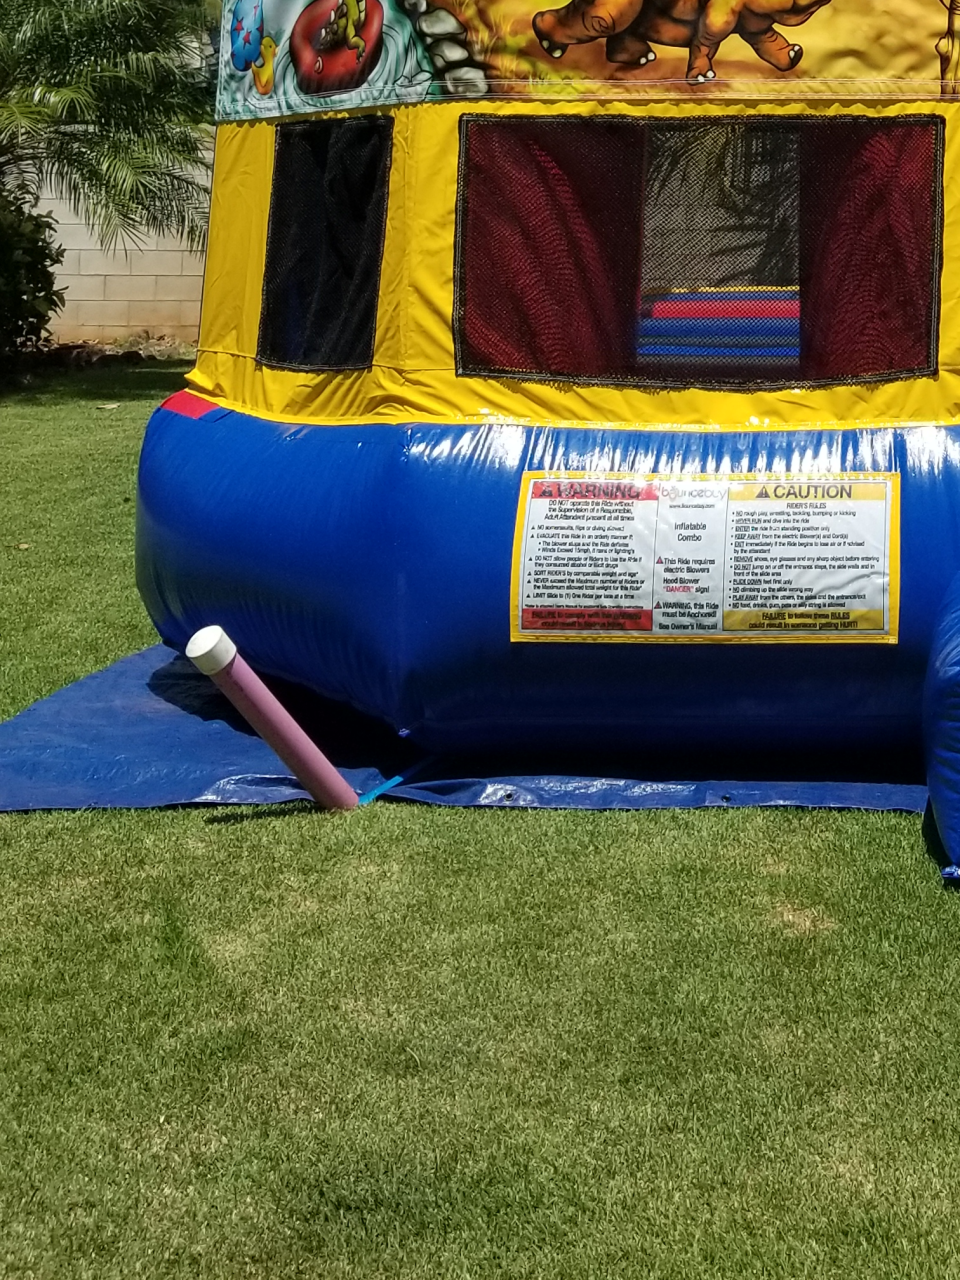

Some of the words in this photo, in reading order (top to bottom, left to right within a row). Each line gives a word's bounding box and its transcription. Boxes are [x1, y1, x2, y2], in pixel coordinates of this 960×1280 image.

[557, 482, 640, 499] WARNING
[774, 484, 852, 499] CAUTION
[675, 522, 706, 530] Inflatable
[677, 533, 702, 542] Combo
[692, 558, 715, 566] requires
[662, 602, 692, 610] WARNING,
[762, 612, 786, 620] FAILURE
